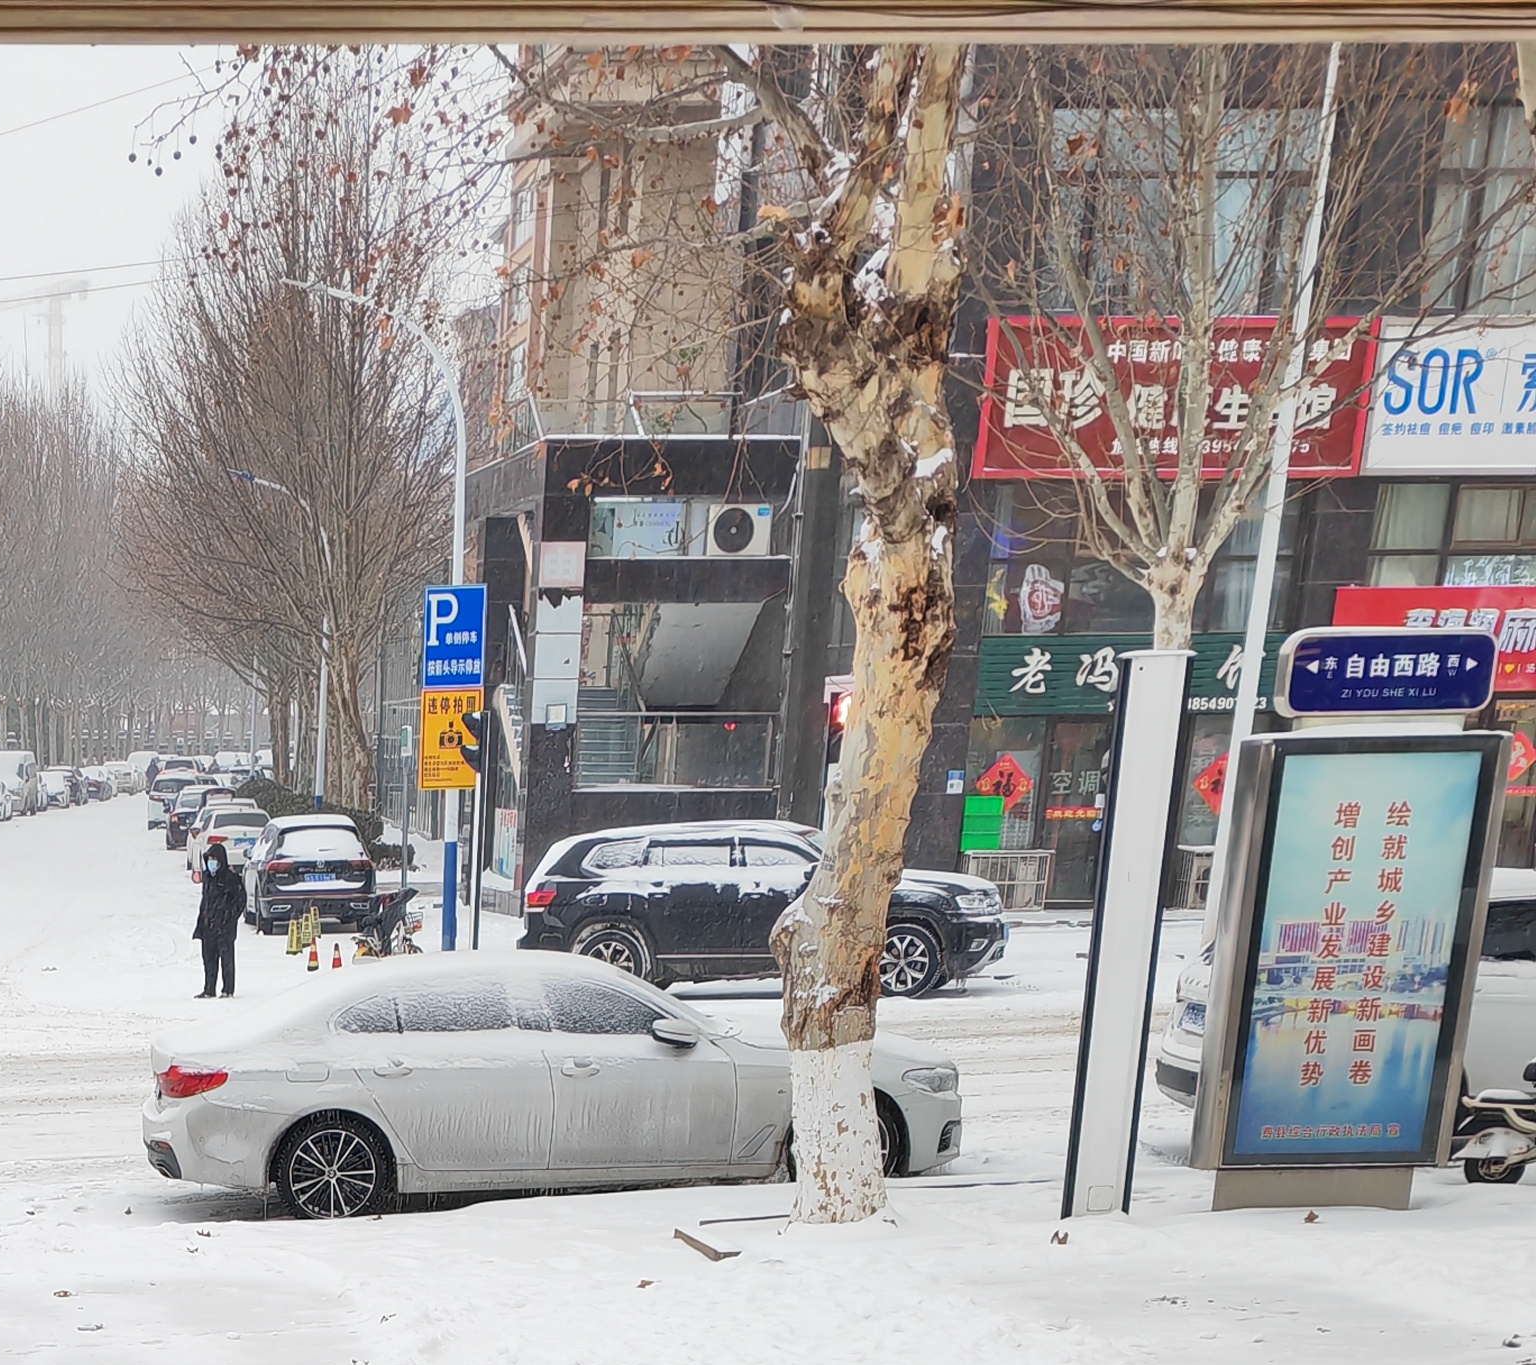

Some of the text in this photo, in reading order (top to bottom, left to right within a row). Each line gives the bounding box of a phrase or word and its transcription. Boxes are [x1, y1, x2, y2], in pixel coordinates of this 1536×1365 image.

[1383, 347, 1484, 415] SOR
[1126, 383, 1337, 430] 健生馆
[445, 631, 478, 645] 单侧停车
[1324, 656, 1338, 670] 东
[1345, 652, 1441, 679] 自由西路
[1341, 688, 1437, 698] ZI YOU SHE XI LU
[1050, 769, 1101, 796] 空调
[1299, 802, 1362, 1087] 增创产业发展新优势
[1347, 801, 1413, 1085] 绘就城乡建设新画卷
